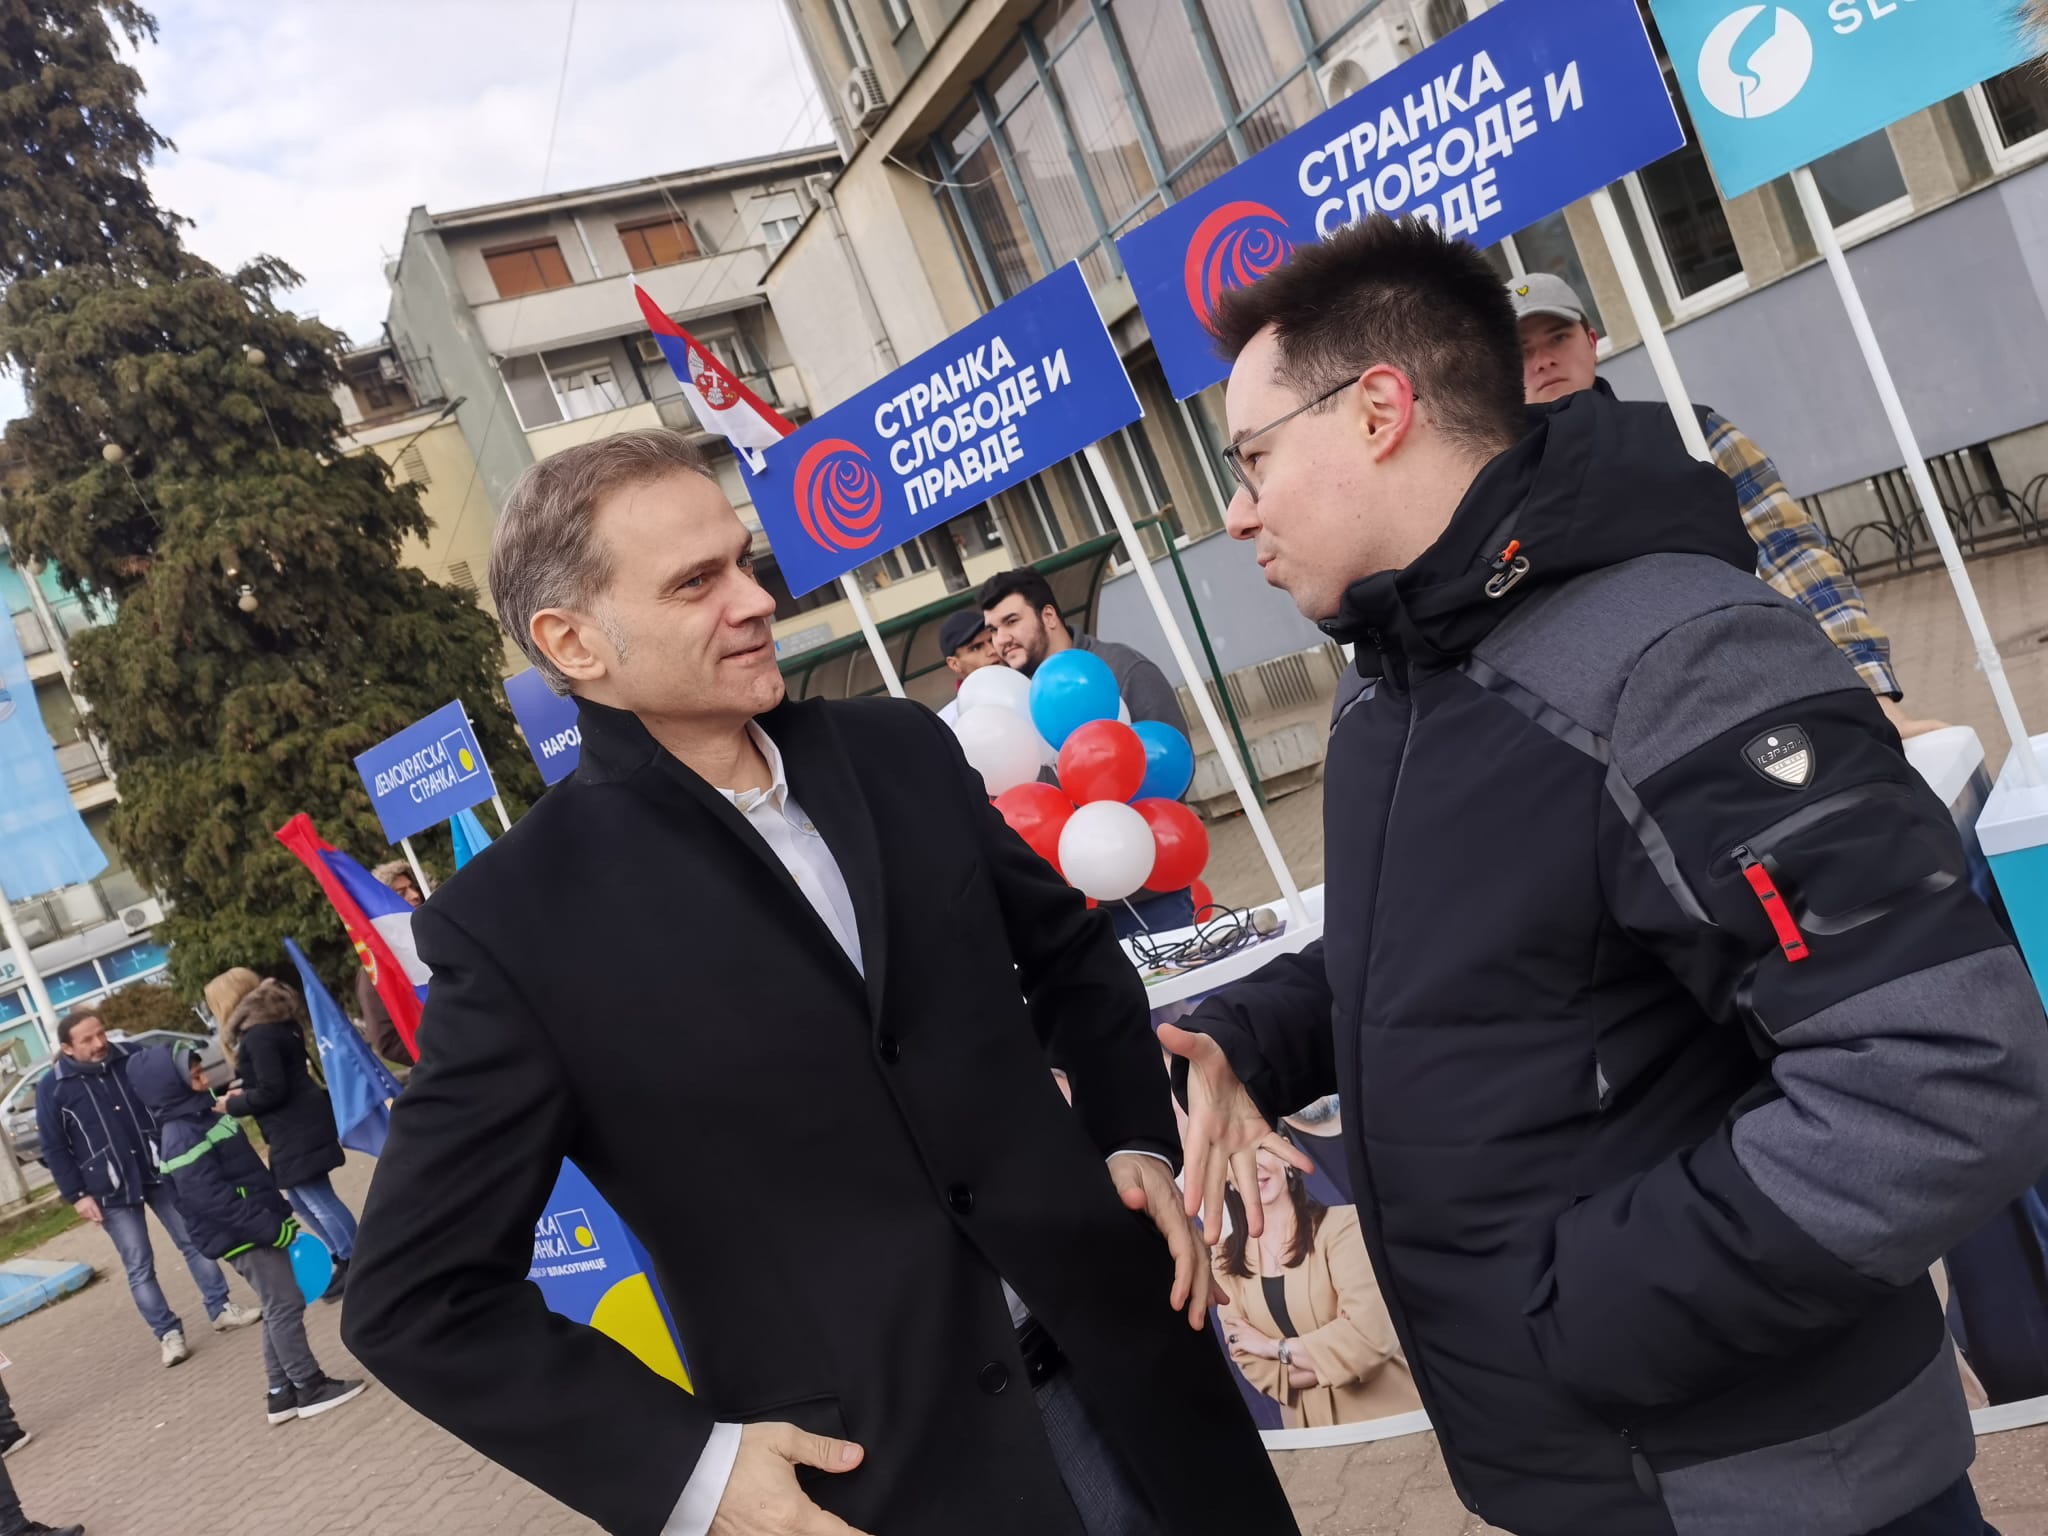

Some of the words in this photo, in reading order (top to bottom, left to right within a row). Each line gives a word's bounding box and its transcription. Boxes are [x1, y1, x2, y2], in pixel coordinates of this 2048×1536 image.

[1298, 50, 1505, 197] СТРАНКА
[1315, 86, 1538, 242] СЛОБОДЕ
[1544, 60, 1584, 123] И
[874, 336, 1016, 439] СТРАНКА
[889, 366, 1042, 476] СЛОБОДЕ
[1041, 348, 1072, 395] И
[903, 424, 1025, 516] ПРАВДЕ
[374, 741, 448, 798] ДЕМОКРАТСКА
[409, 764, 457, 804] СТРАНКА
